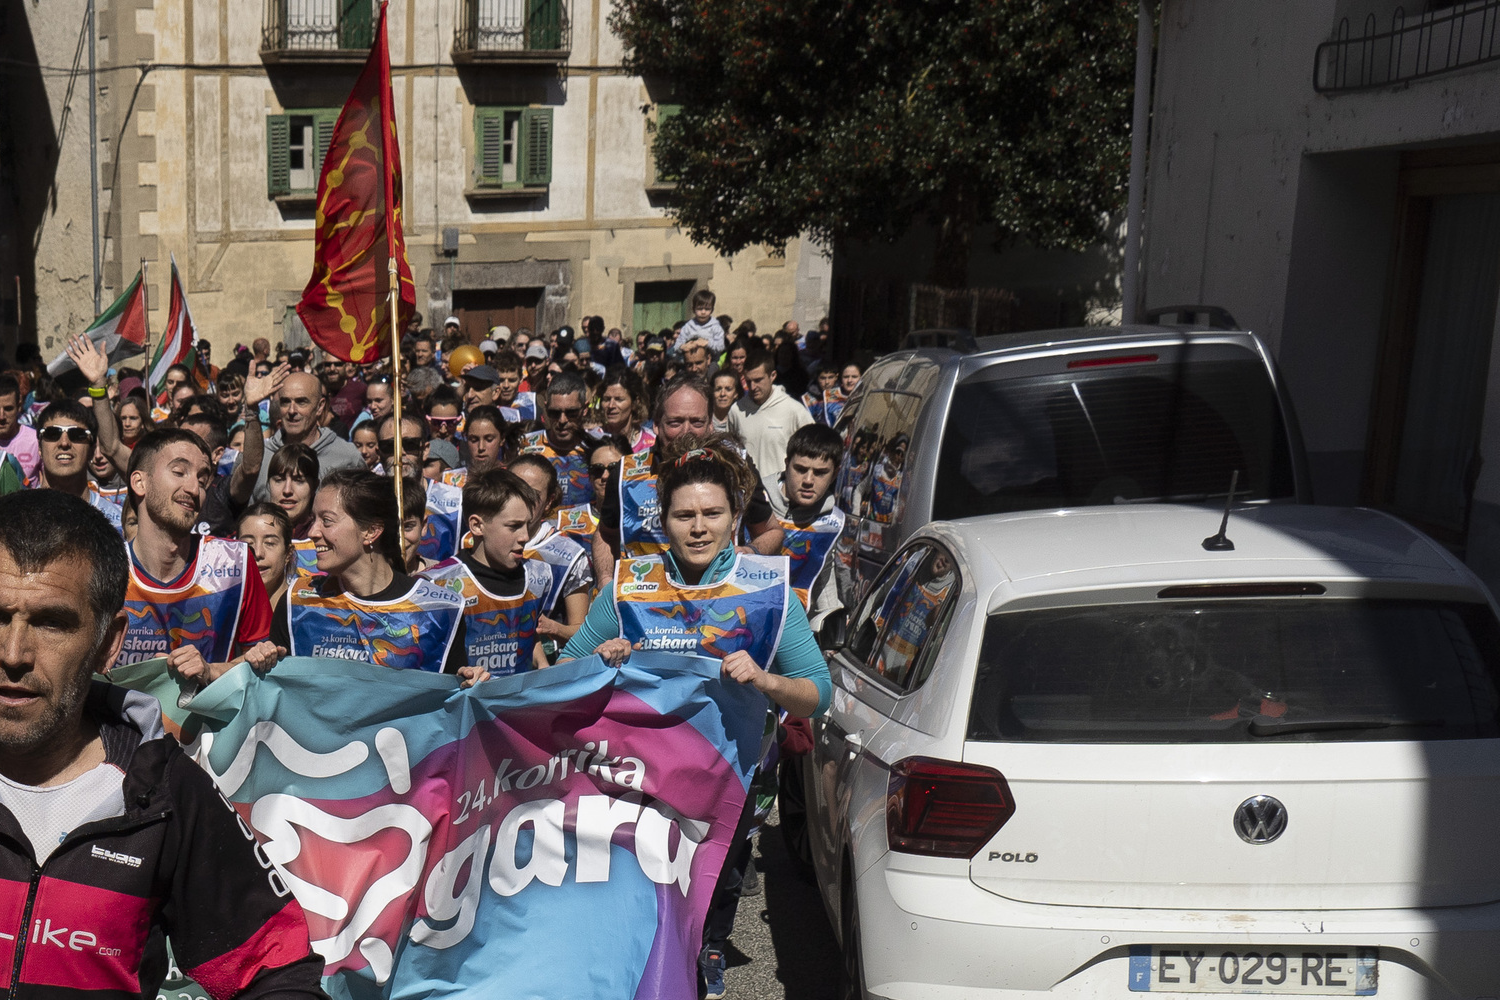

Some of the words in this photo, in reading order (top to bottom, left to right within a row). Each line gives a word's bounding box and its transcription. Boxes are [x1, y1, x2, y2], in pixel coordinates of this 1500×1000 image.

[437, 498, 457, 508] eitb
[553, 548, 573, 562] eitb
[215, 564, 241, 577] eitb
[749, 569, 779, 580] eitb
[429, 590, 459, 602] eitb
[127, 626, 154, 635] korrika
[645, 626, 683, 635] 24.korrika
[123, 637, 167, 651] skara
[321, 634, 357, 643] 24.korrika
[639, 636, 697, 650] Euskara
[312, 644, 370, 661] Euskara
[468, 641, 518, 657] Euskara
[476, 653, 517, 672] gara
[452, 740, 646, 825] 24.korrika
[988, 851, 1039, 863] POLO
[409, 792, 711, 950] gara
[1158, 950, 1348, 987] EY-029-RE
